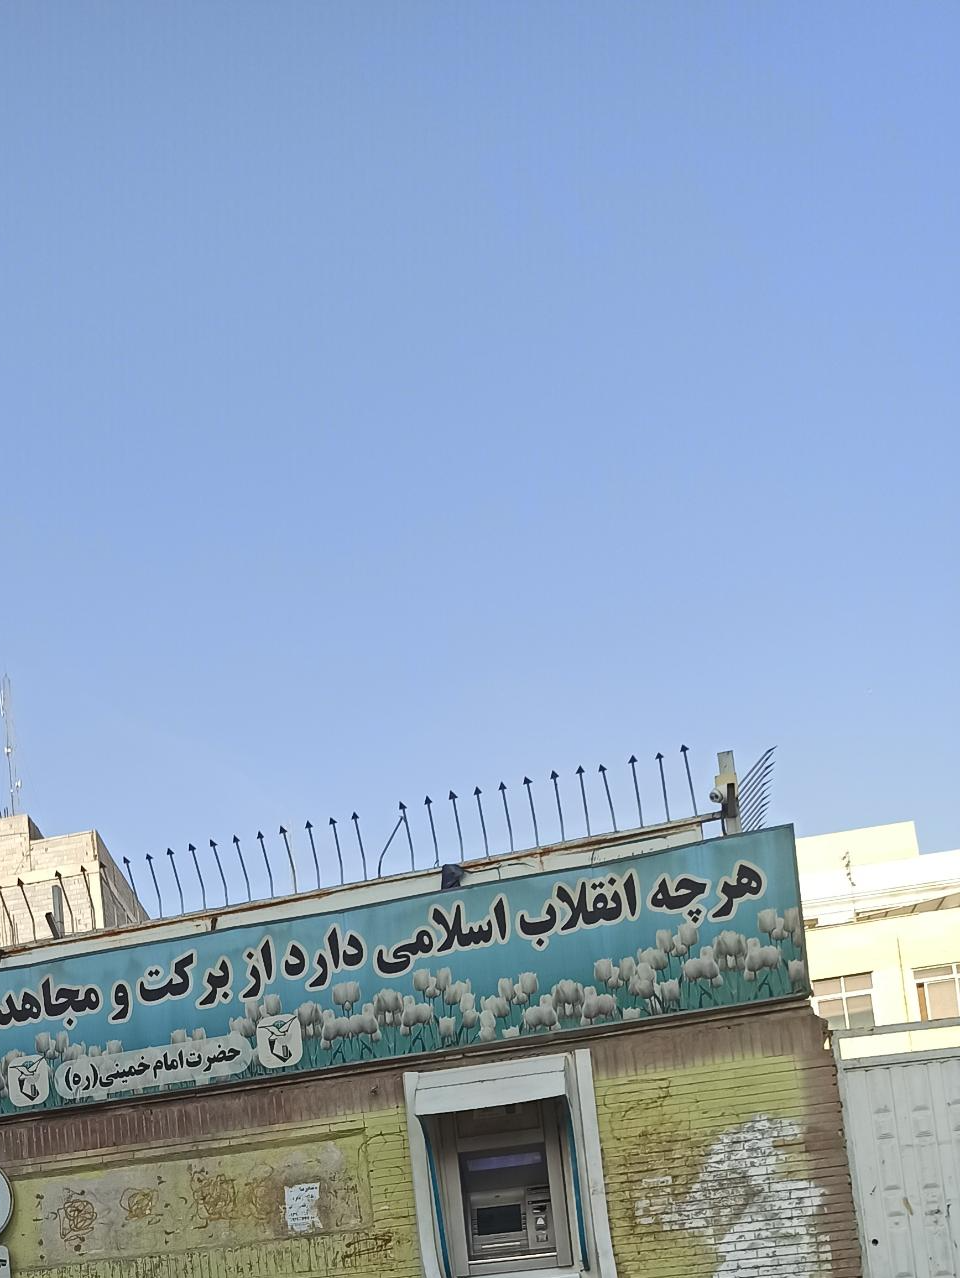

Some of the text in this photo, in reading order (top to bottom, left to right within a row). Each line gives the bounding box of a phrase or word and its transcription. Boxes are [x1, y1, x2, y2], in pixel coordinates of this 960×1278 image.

[377, 897, 507, 974] اسلامی
[520, 873, 638, 947] انقلاب
[140, 952, 230, 1006] برکت
[243, 939, 273, 999] از
[285, 927, 364, 988] دارد
[112, 983, 129, 1021] و
[153, 1049, 184, 1079] امام
[189, 1044, 241, 1072] حضرت
